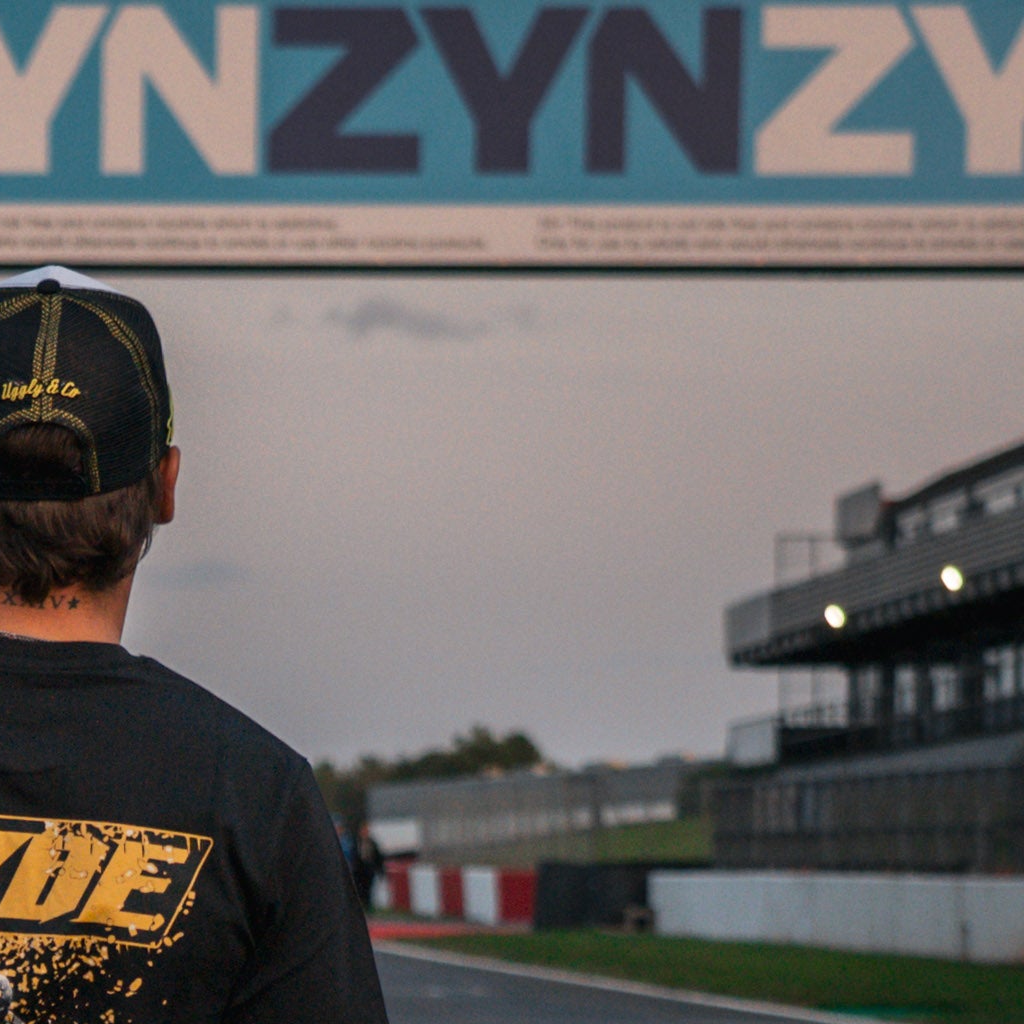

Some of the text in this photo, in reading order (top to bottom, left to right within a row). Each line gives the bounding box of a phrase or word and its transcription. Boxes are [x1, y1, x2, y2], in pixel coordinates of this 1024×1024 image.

[267, 6, 743, 177] ZYN
[1, 378, 81, 402] Uggly & Co
